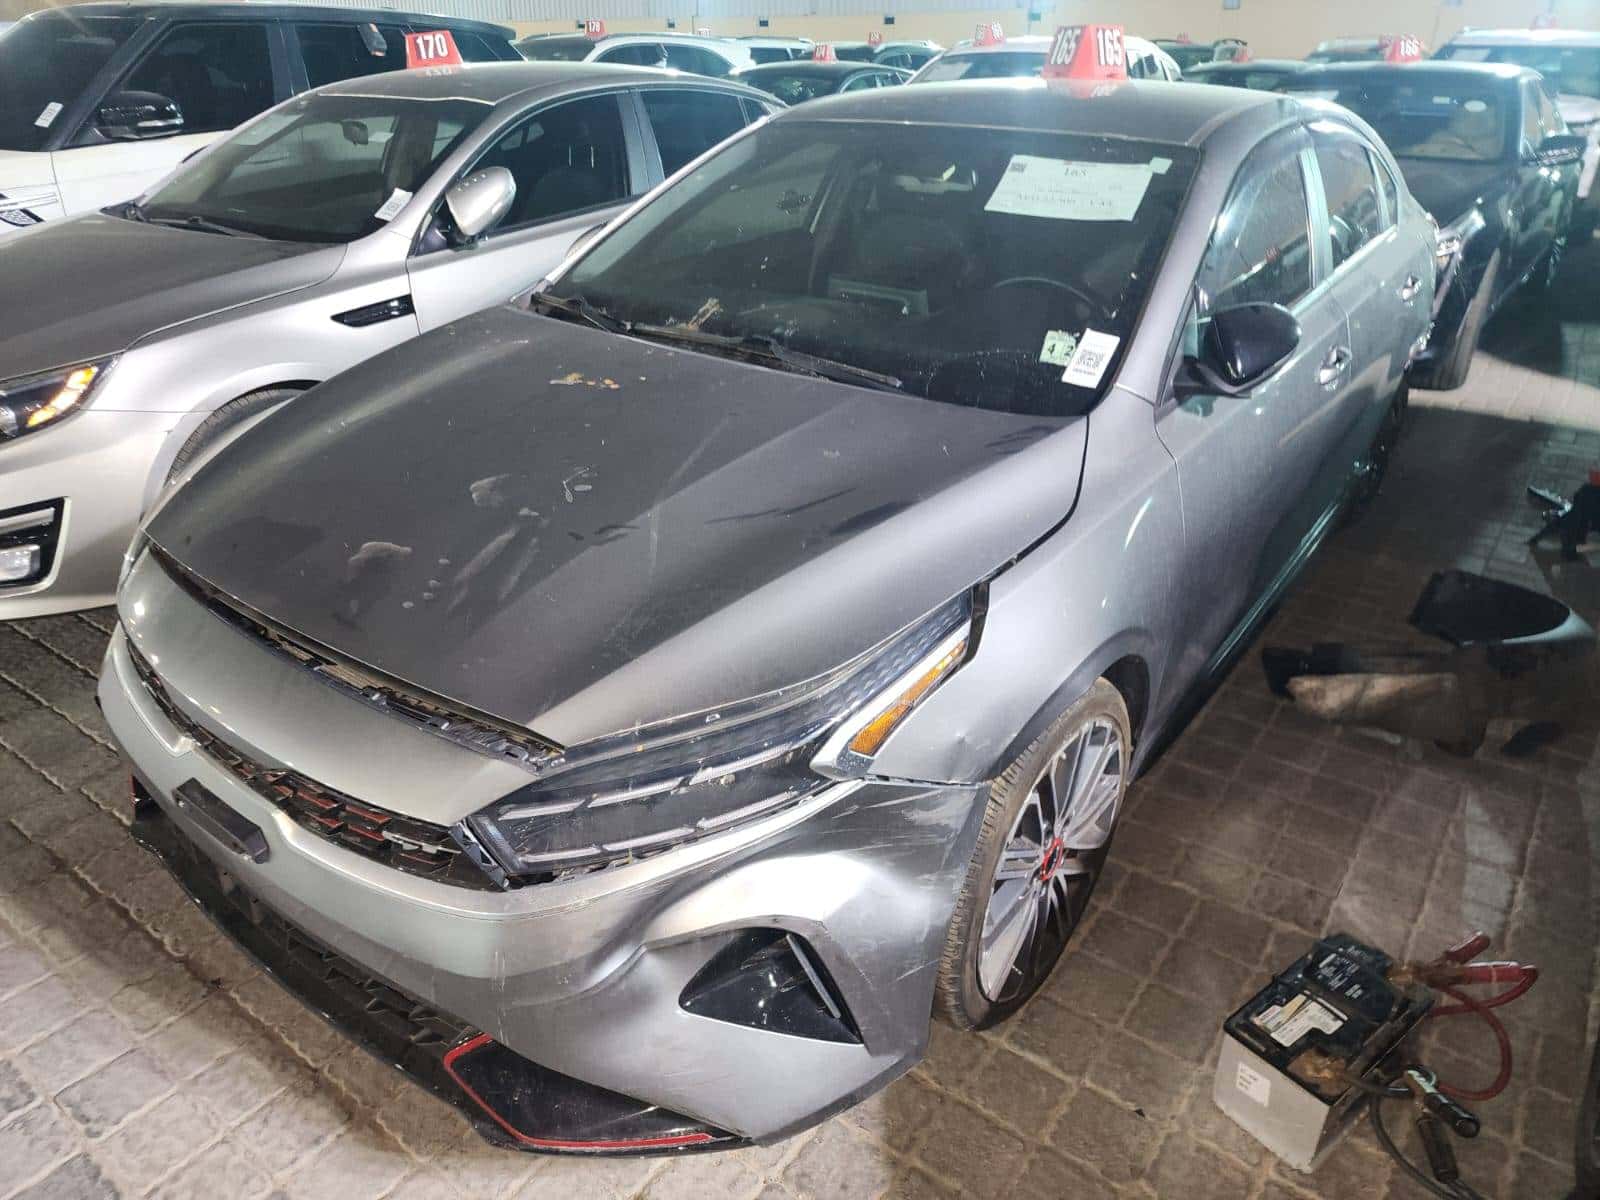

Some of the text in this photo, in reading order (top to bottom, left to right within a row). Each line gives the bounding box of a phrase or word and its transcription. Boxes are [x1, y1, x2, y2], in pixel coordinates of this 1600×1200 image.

[416, 33, 449, 60] 170
[1050, 28, 1081, 65] 165
[1097, 28, 1122, 65] 165
